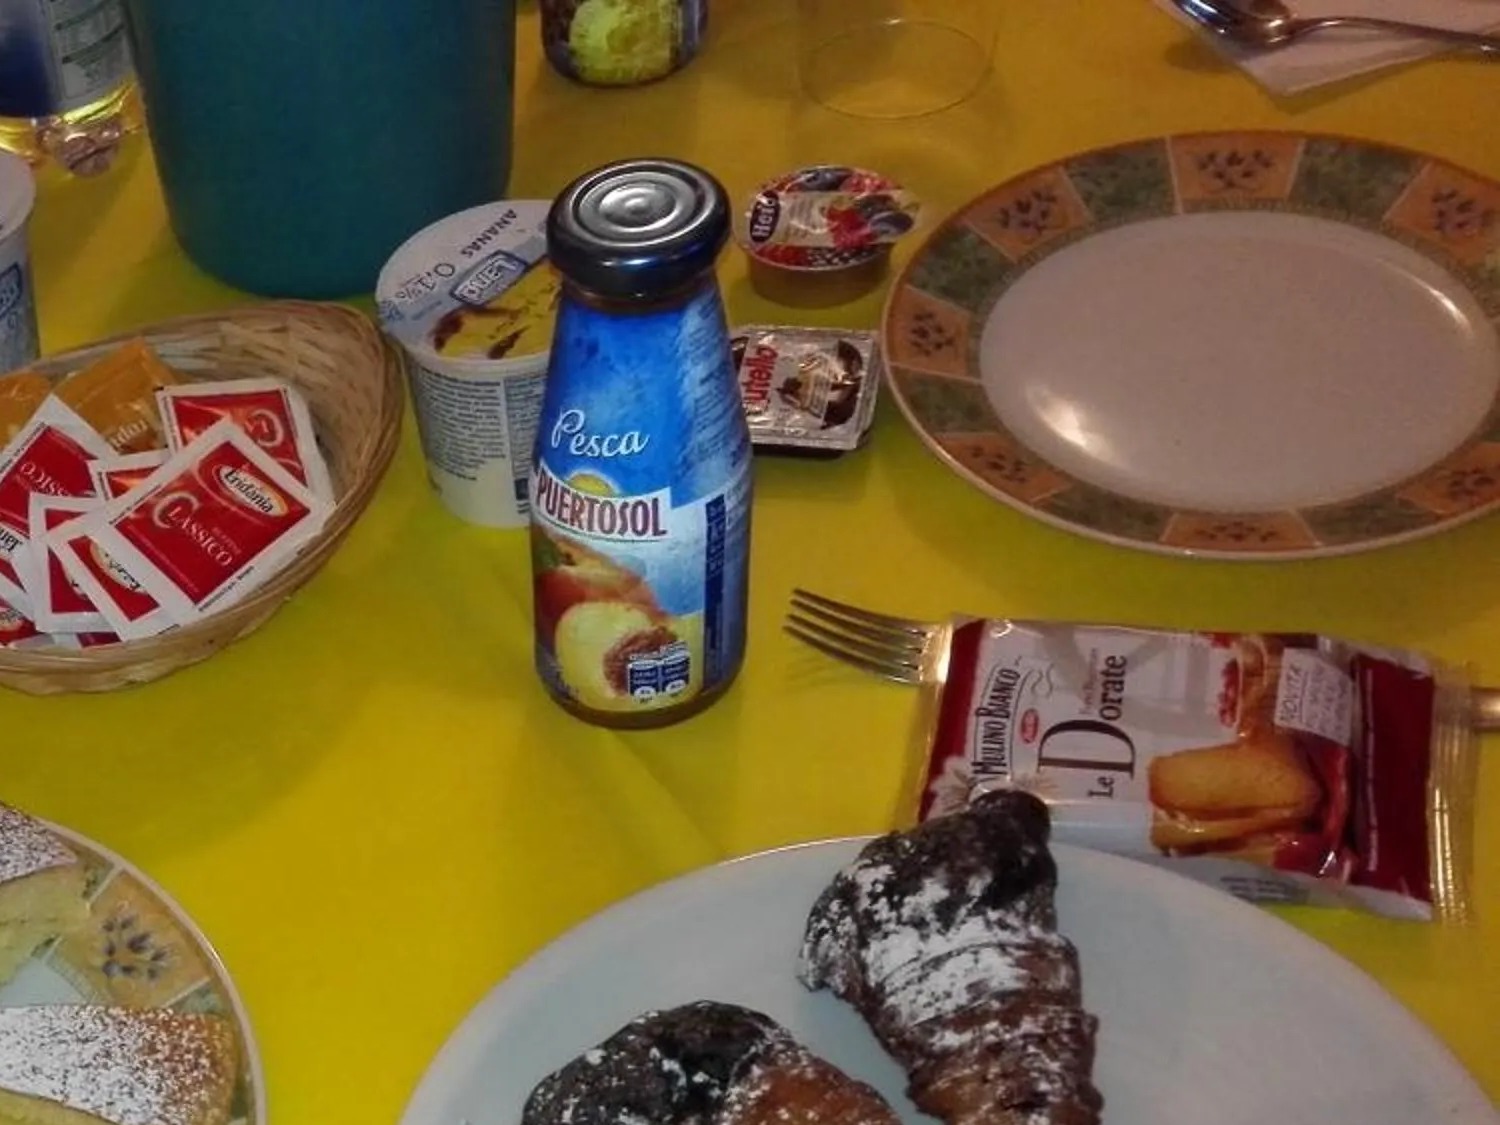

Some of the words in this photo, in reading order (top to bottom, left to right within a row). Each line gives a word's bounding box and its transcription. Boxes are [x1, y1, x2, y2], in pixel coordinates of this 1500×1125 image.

[460, 208, 518, 260] ANANAS
[551, 409, 651, 458] Pesca
[152, 489, 234, 567] CLASSICO
[536, 473, 670, 538] PUERTOSOL
[975, 667, 1021, 720] BIANCO
[1037, 654, 1136, 779] Dorate
[972, 720, 1003, 778] MULINO
[1088, 775, 1115, 800] Le
